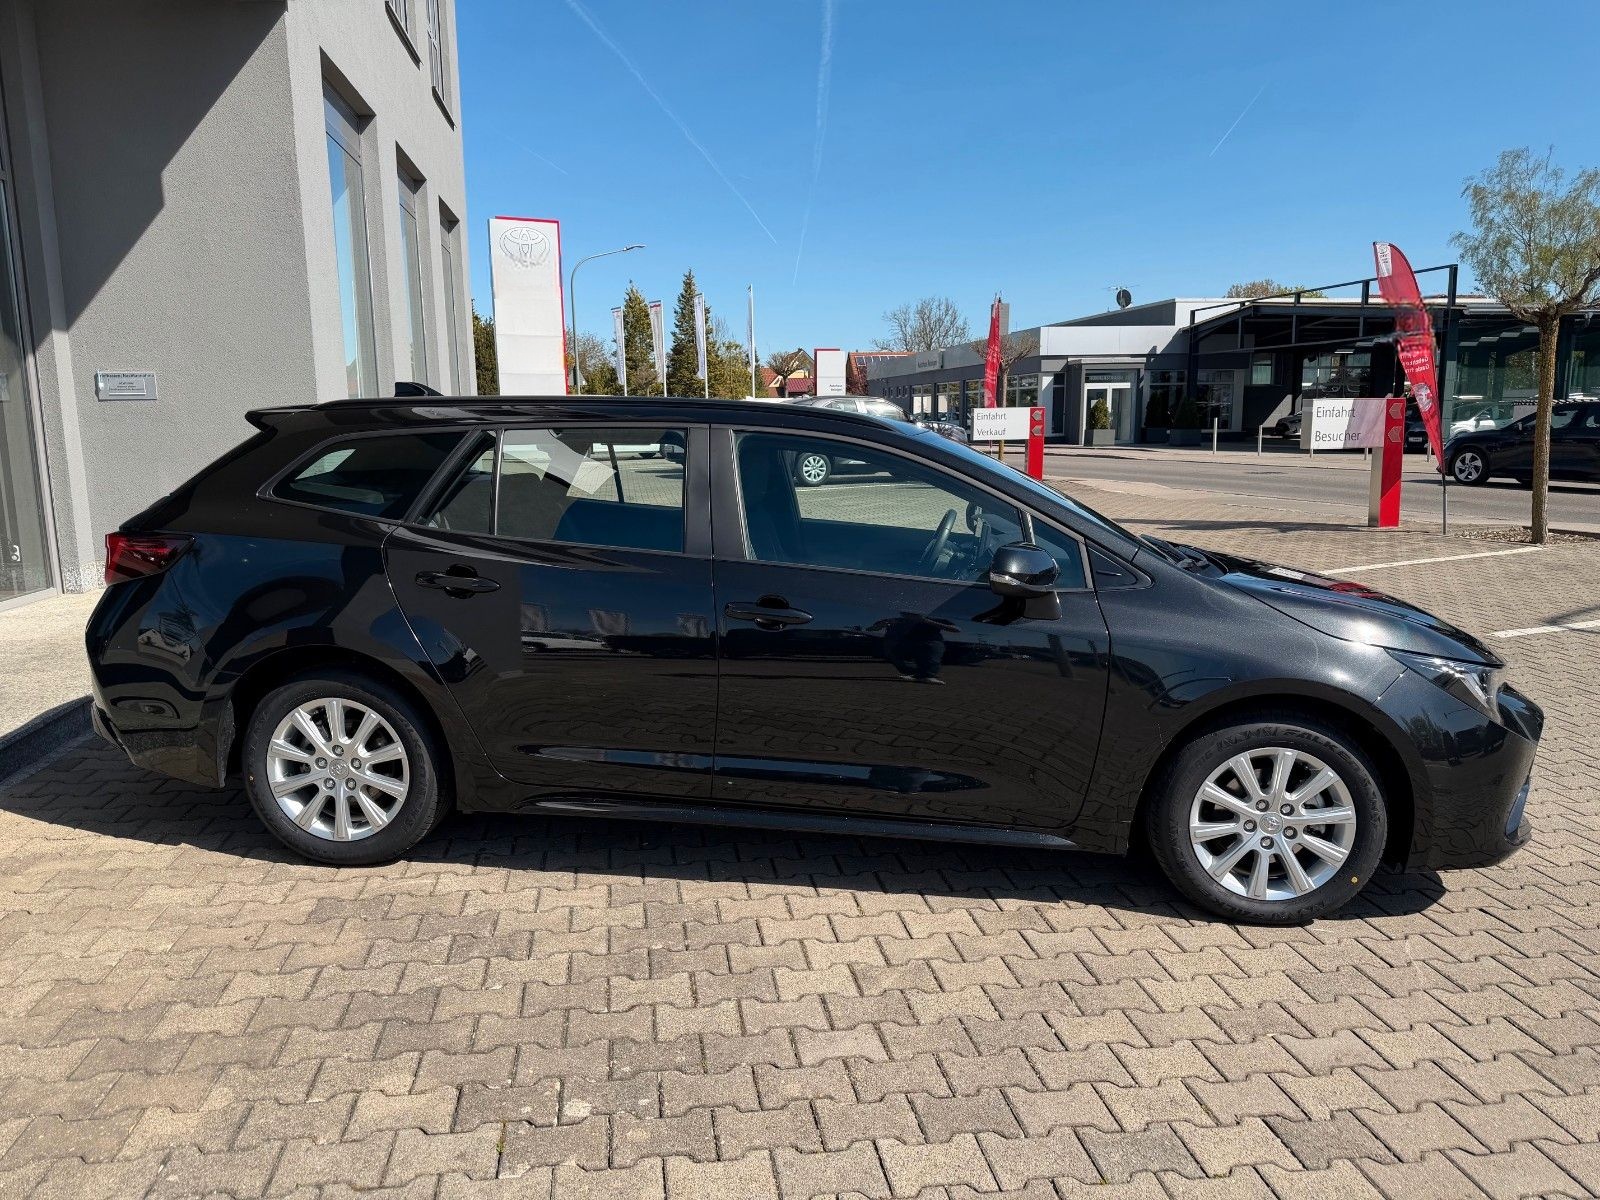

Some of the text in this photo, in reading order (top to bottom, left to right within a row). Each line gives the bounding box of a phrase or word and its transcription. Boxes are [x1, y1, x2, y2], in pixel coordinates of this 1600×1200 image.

[976, 412, 1007, 421] Einfahrt
[1316, 406, 1356, 418] Einfahrt
[976, 428, 1007, 436] Verkauf
[1314, 430, 1361, 442] Besucher
